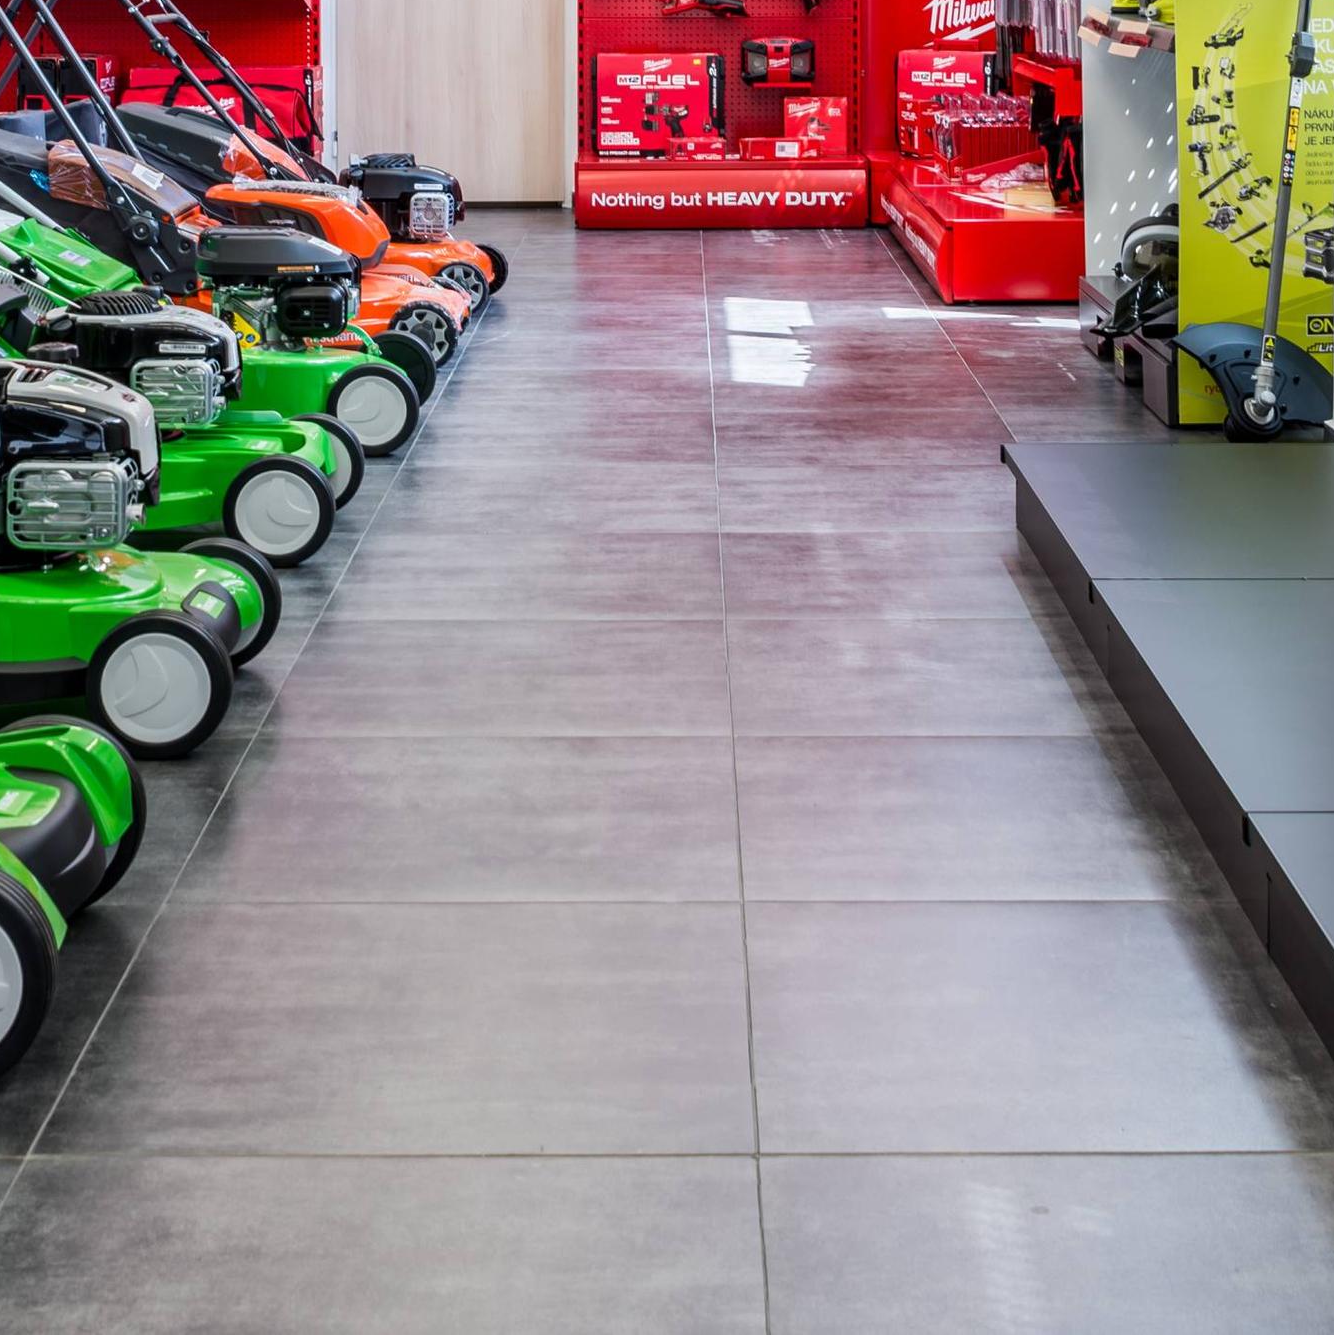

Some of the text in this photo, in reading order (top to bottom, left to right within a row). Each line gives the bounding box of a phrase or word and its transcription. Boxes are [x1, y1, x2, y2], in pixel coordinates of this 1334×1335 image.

[641, 74, 700, 86] FUEL
[931, 72, 977, 85] FUEL
[1303, 80, 1328, 95] NA
[1304, 136, 1317, 146] JE
[590, 191, 665, 210] Nothing
[670, 191, 702, 207] but
[706, 191, 780, 207] HEAVY
